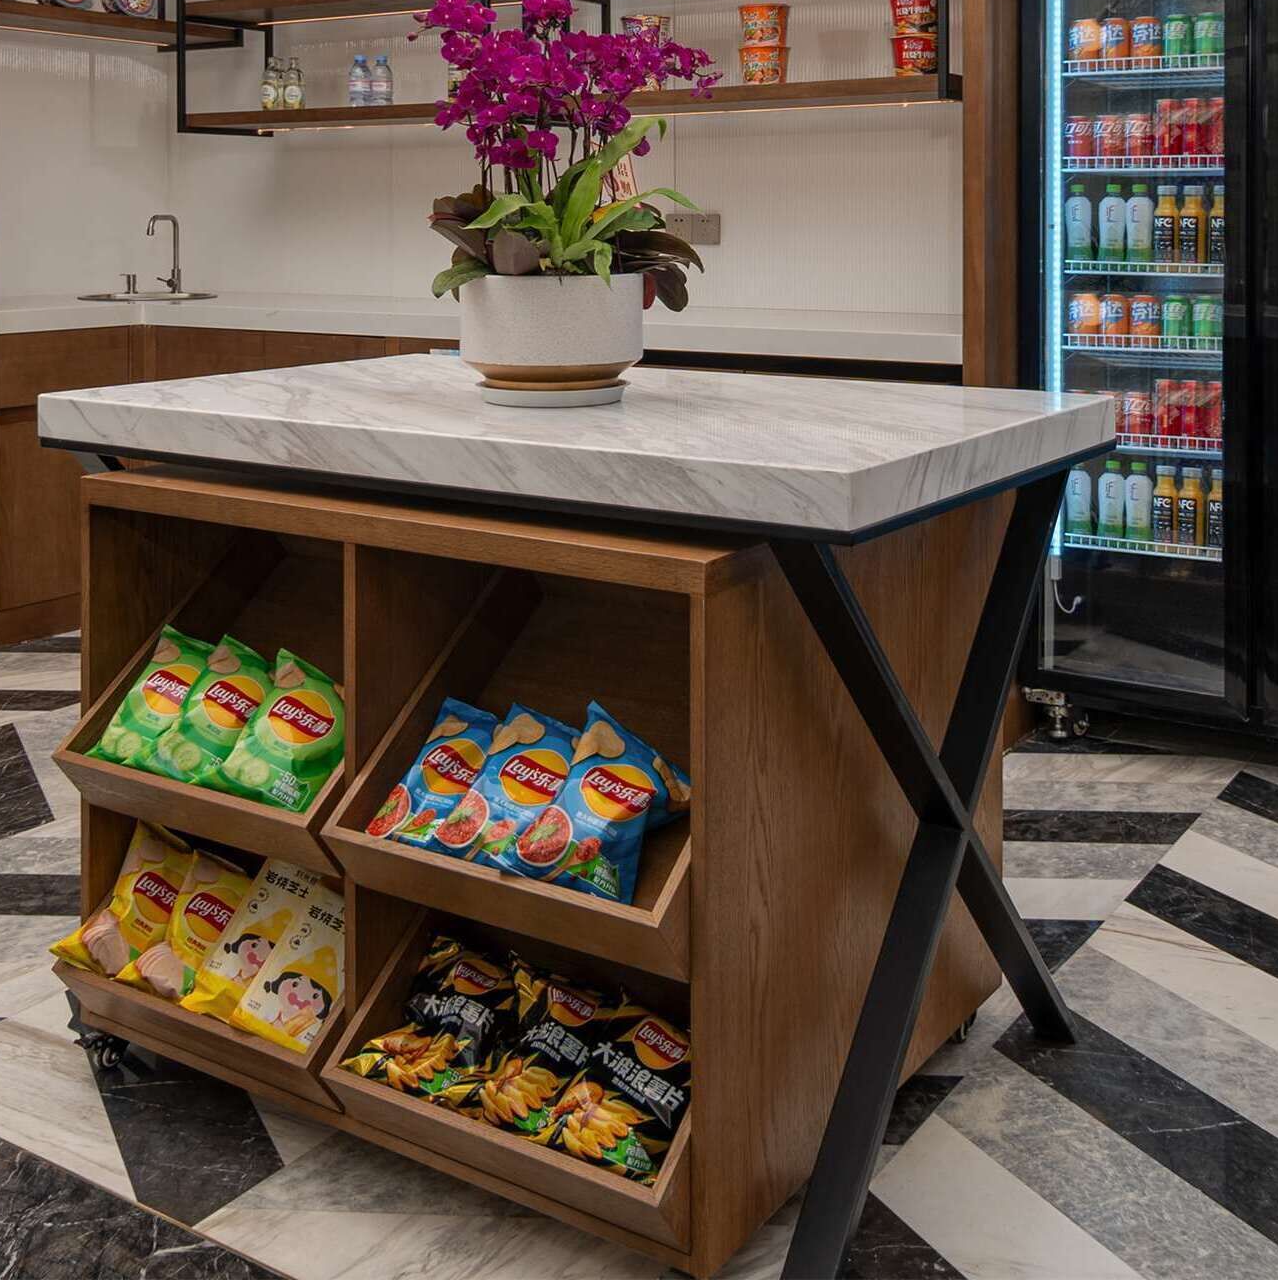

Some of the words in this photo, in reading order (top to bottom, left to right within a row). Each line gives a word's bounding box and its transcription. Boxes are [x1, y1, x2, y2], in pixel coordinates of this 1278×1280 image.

[265, 870, 310, 900] 岩烧芝士
[592, 1041, 685, 1112] 大波浪薯片
